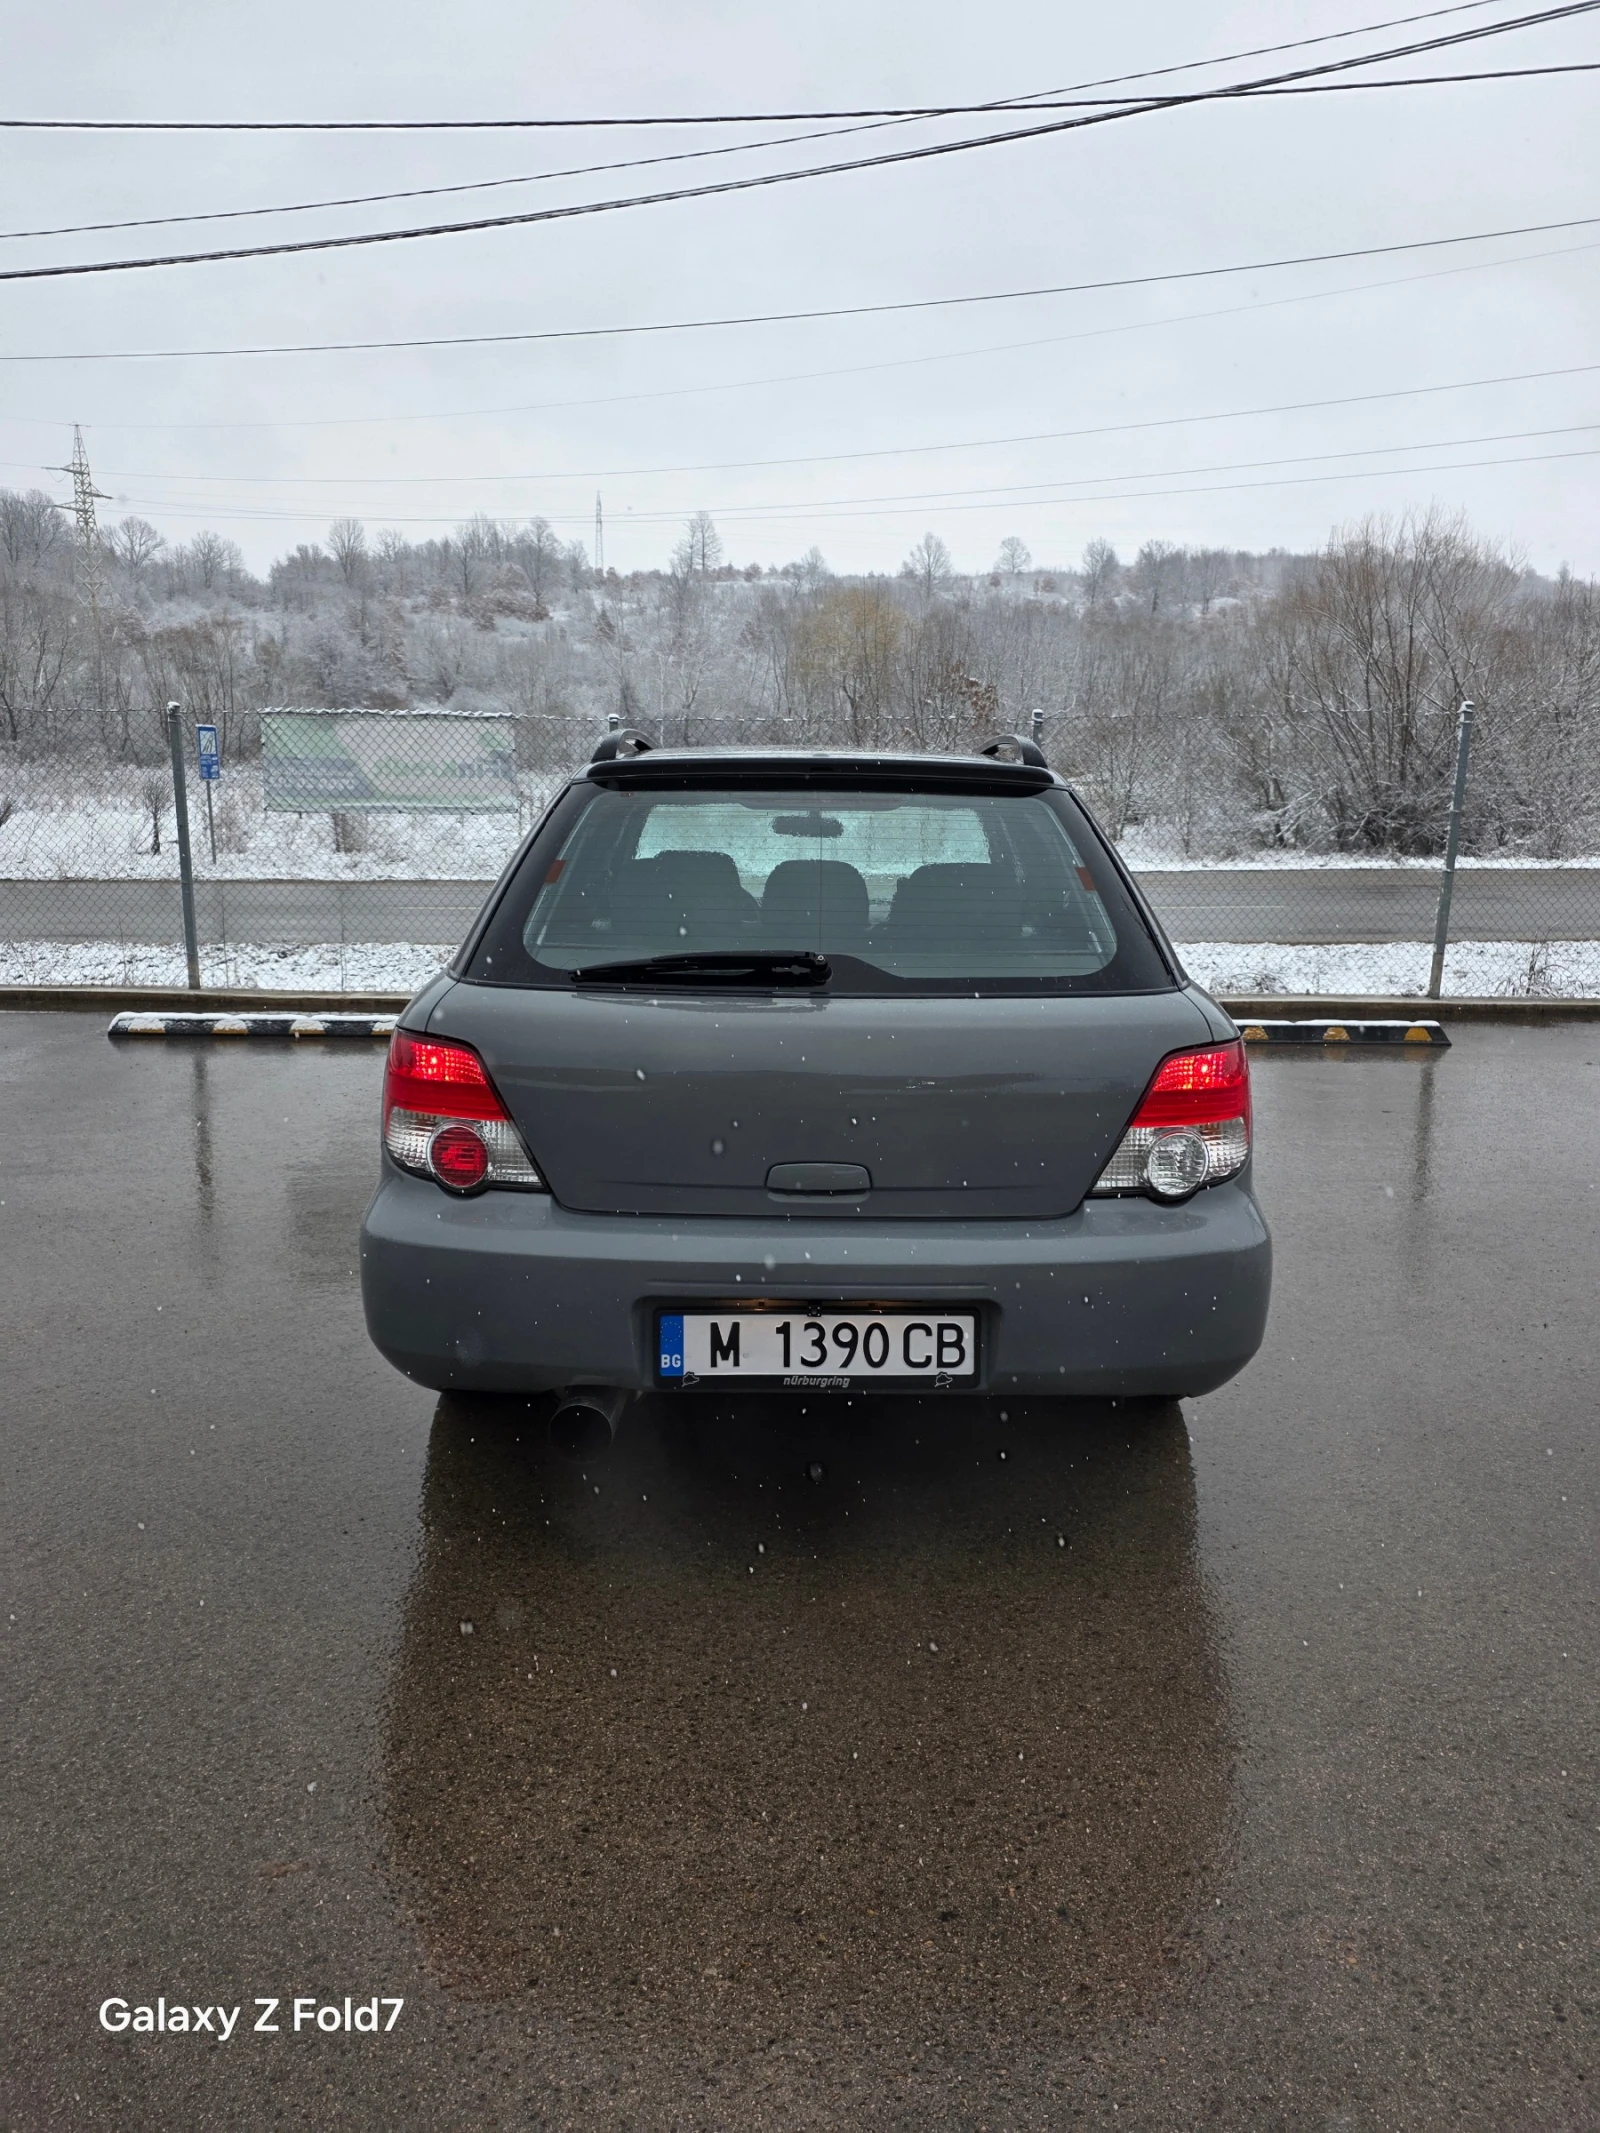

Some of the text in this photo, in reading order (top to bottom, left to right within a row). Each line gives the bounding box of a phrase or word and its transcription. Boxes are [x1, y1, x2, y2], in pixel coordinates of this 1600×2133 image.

[710, 1321, 966, 1369] M 1390 CB
[661, 1354, 681, 1368] BG
[783, 1375, 850, 1388] nürburgring
